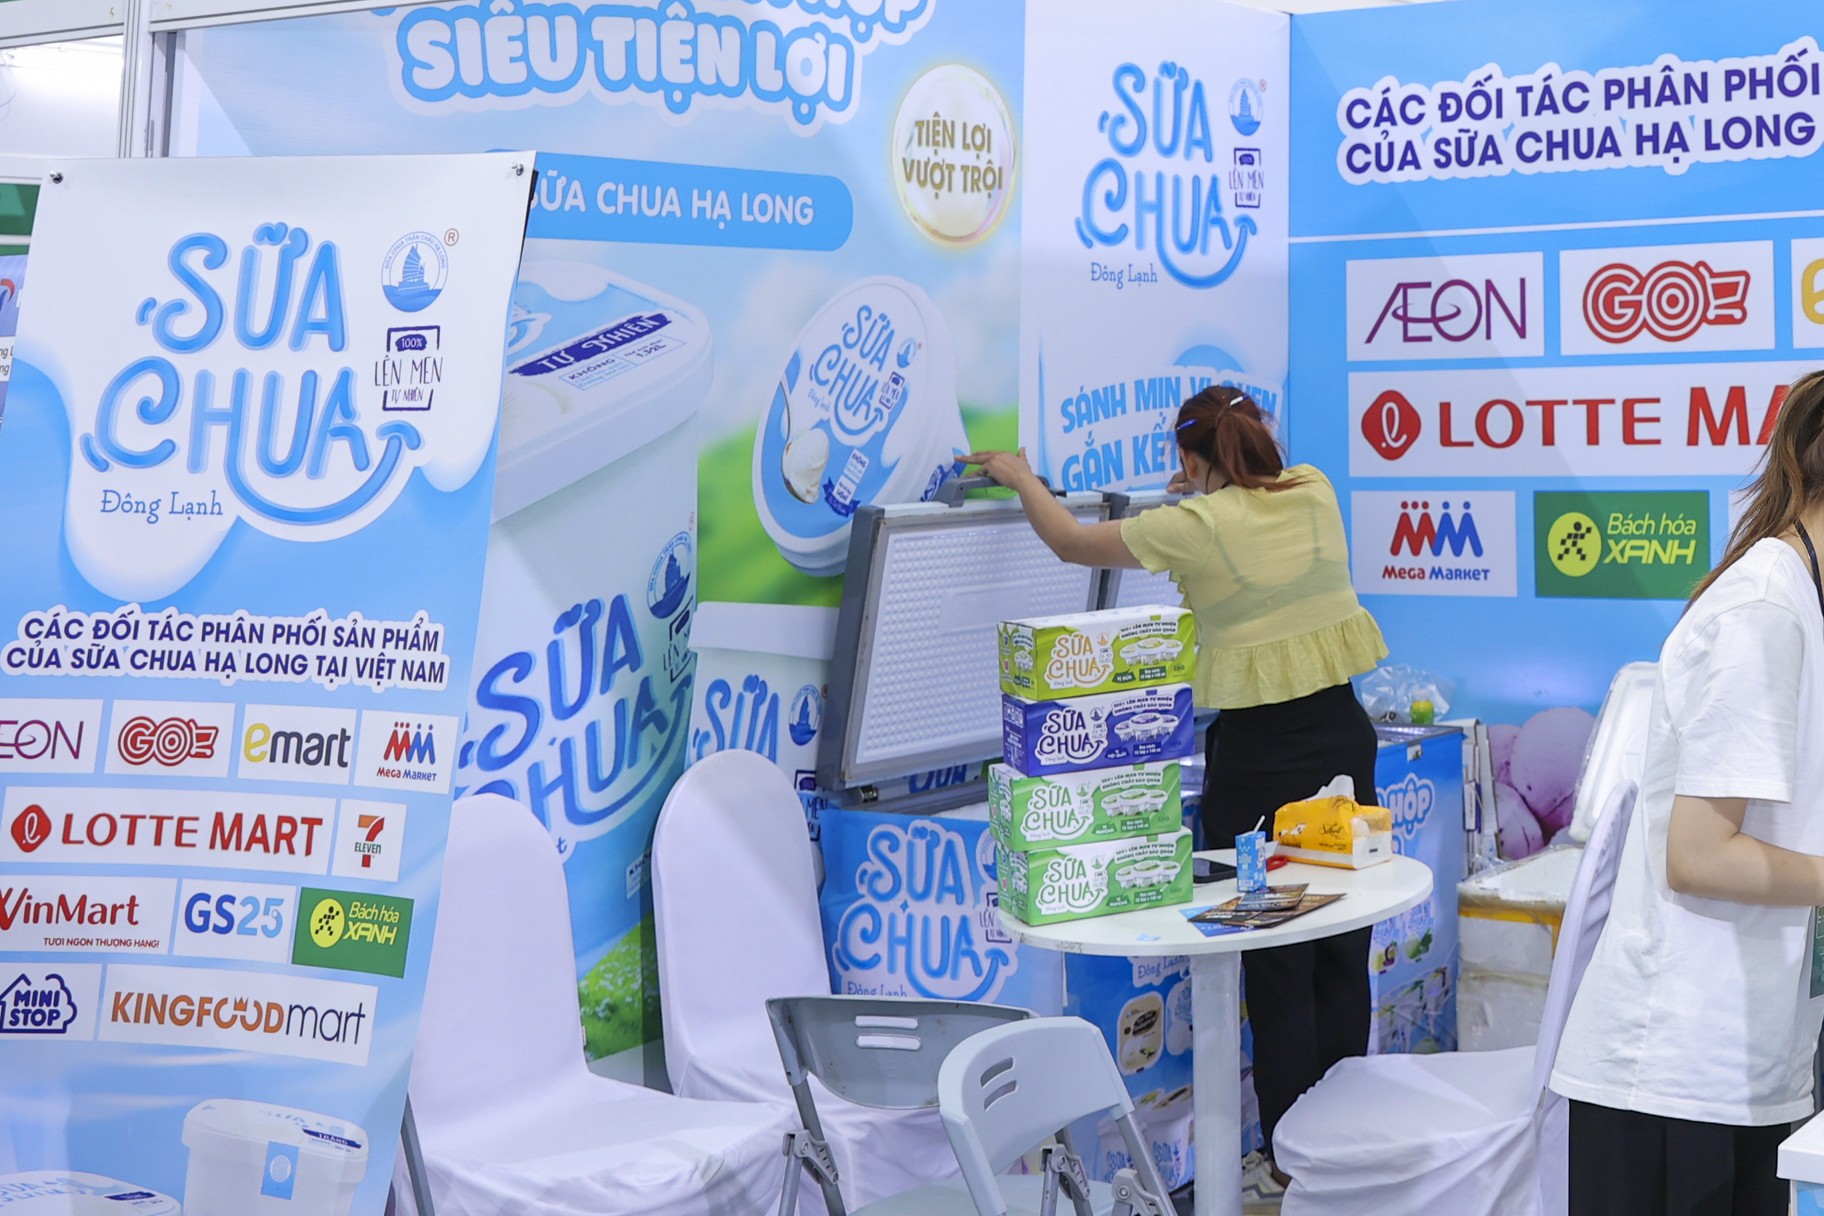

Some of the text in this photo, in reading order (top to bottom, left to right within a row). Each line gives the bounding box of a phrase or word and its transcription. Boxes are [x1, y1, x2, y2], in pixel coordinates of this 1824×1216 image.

[406, 0, 847, 117] SIÊU TIỆN LỢI
[1099, 60, 1213, 163] SỮA
[1346, 88, 1426, 130] CÁC
[1438, 73, 1504, 122] ĐỐI
[1516, 75, 1590, 117] TÁC
[1604, 67, 1709, 112] PHÂN
[1724, 49, 1821, 102] PHỐI
[914, 111, 992, 156] TIỆN LỢI
[1346, 128, 1421, 174] CỦA
[1433, 128, 1500, 170] SỮA
[1516, 125, 1622, 163] CHUA
[1635, 120, 1697, 165] HẠ
[1704, 110, 1816, 152] LONG
[902, 160, 1004, 200] VƯỢT TRỘI
[597, 182, 814, 230] CHUA HẠ LONG
[1075, 158, 1257, 290] CHUA
[135, 222, 350, 353] SỮA
[1091, 262, 1158, 290] Đông Lạnh
[1365, 278, 1527, 345] ÆON
[400, 337, 424, 350] 100%
[537, 349, 575, 371] TỰ
[580, 317, 661, 352] NHIÊN
[842, 305, 895, 372] SỮA
[375, 354, 444, 388] LÊN MEN
[809, 345, 884, 437] CHUA
[1060, 384, 1127, 434] SÁNH
[1439, 397, 1662, 449] LOTTE
[80, 355, 423, 527] CHUA
[1061, 430, 1125, 493] GẮN
[100, 489, 224, 524] Đông Lạnh
[1607, 512, 1697, 536] Bách hóa
[1602, 539, 1695, 566] XANH
[24, 609, 440, 653] CÁC ĐỐI TÁC PHÂN PHỐI SẢN PHẨM
[1052, 634, 1094, 659] SỮA
[6, 641, 446, 687] CỦA SỮA CHUA HẠ LONG TẠI VIỆT NAM
[458, 593, 644, 772] SỮA
[1046, 657, 1111, 685] CHUA
[1043, 709, 1086, 735] SỮA
[244, 723, 351, 768] emart
[1037, 733, 1104, 761] CHUA
[1028, 785, 1072, 810] SỮA
[1393, 782, 1431, 832] HỘP
[62, 811, 324, 857] LOTTE MART
[1022, 809, 1090, 836] CHUA
[354, 841, 382, 855] ELEVEN
[857, 826, 966, 906] SỮA
[1043, 856, 1087, 883] SỮA
[184, 892, 284, 939] GS25
[348, 900, 400, 922] Bách hóa
[1036, 882, 1105, 909] CHUA
[66, 937, 94, 947] NGON
[344, 922, 398, 946] XANH
[835, 903, 1009, 1000] CHUA
[8, 1007, 61, 1027] STOP
[13, 989, 61, 1008] MINI
[110, 991, 366, 1045] KINGFOODmart
